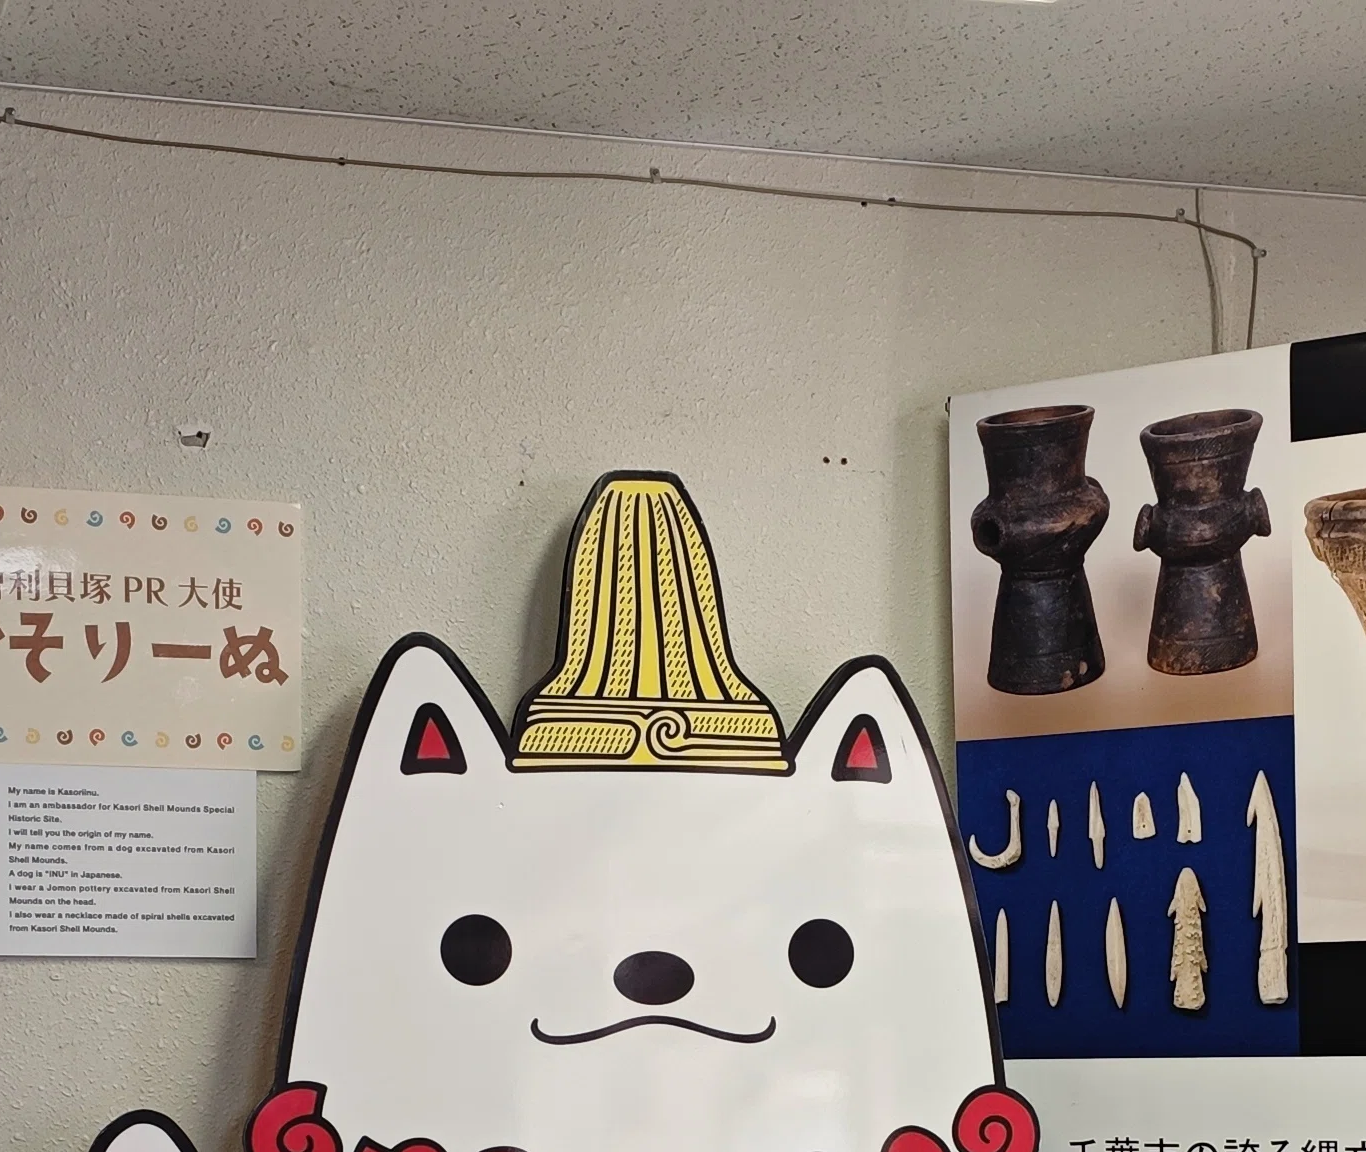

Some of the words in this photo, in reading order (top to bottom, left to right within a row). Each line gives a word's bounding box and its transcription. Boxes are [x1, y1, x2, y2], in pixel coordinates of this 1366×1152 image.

[123, 575, 168, 607] PR
[178, 576, 242, 610] 大使
[7, 786, 21, 796] My
[47, 787, 55, 795] is
[41, 801, 96, 810] ambassador
[97, 802, 111, 810] for
[112, 802, 141, 811] Kasori
[142, 803, 164, 812] Shell
[166, 804, 201, 813] Mounds
[202, 805, 235, 814] Special
[7, 814, 41, 822] Historic
[42, 814, 62, 823] Site.
[29, 828, 43, 836] tell
[44, 830, 60, 838] you
[61, 829, 76, 837] the
[77, 829, 102, 839] origin
[113, 831, 127, 839] my
[8, 841, 22, 851] My
[83, 843, 104, 851] from
[115, 844, 133, 853] dog
[135, 845, 181, 853] excavated
[183, 845, 204, 853] from
[206, 845, 235, 854] Kasori
[8, 855, 29, 863] Shell
[31, 855, 68, 864] Mounds.
[8, 869, 15, 877] A
[16, 869, 33, 879] dog
[35, 869, 43, 877] is
[70, 870, 78, 878] in
[79, 870, 122, 879] Japanese.
[45, 883, 76, 891] Jomon
[78, 884, 111, 894] pottery
[112, 885, 158, 893] excavated
[160, 885, 181, 893] from
[182, 886, 211, 894] Kasori
[213, 886, 235, 894] Shell
[8, 896, 43, 905] Mounds
[57, 897, 71, 905] the
[72, 897, 96, 905] head.
[14, 910, 32, 918] also
[64, 911, 102, 919] necklace
[140, 912, 164, 921] spiral
[166, 912, 190, 920] shells
[192, 913, 235, 921] excavated
[8, 924, 28, 932] from
[30, 924, 57, 932] Kasori
[59, 924, 80, 932] Shell
[82, 924, 118, 933] Mounds.
